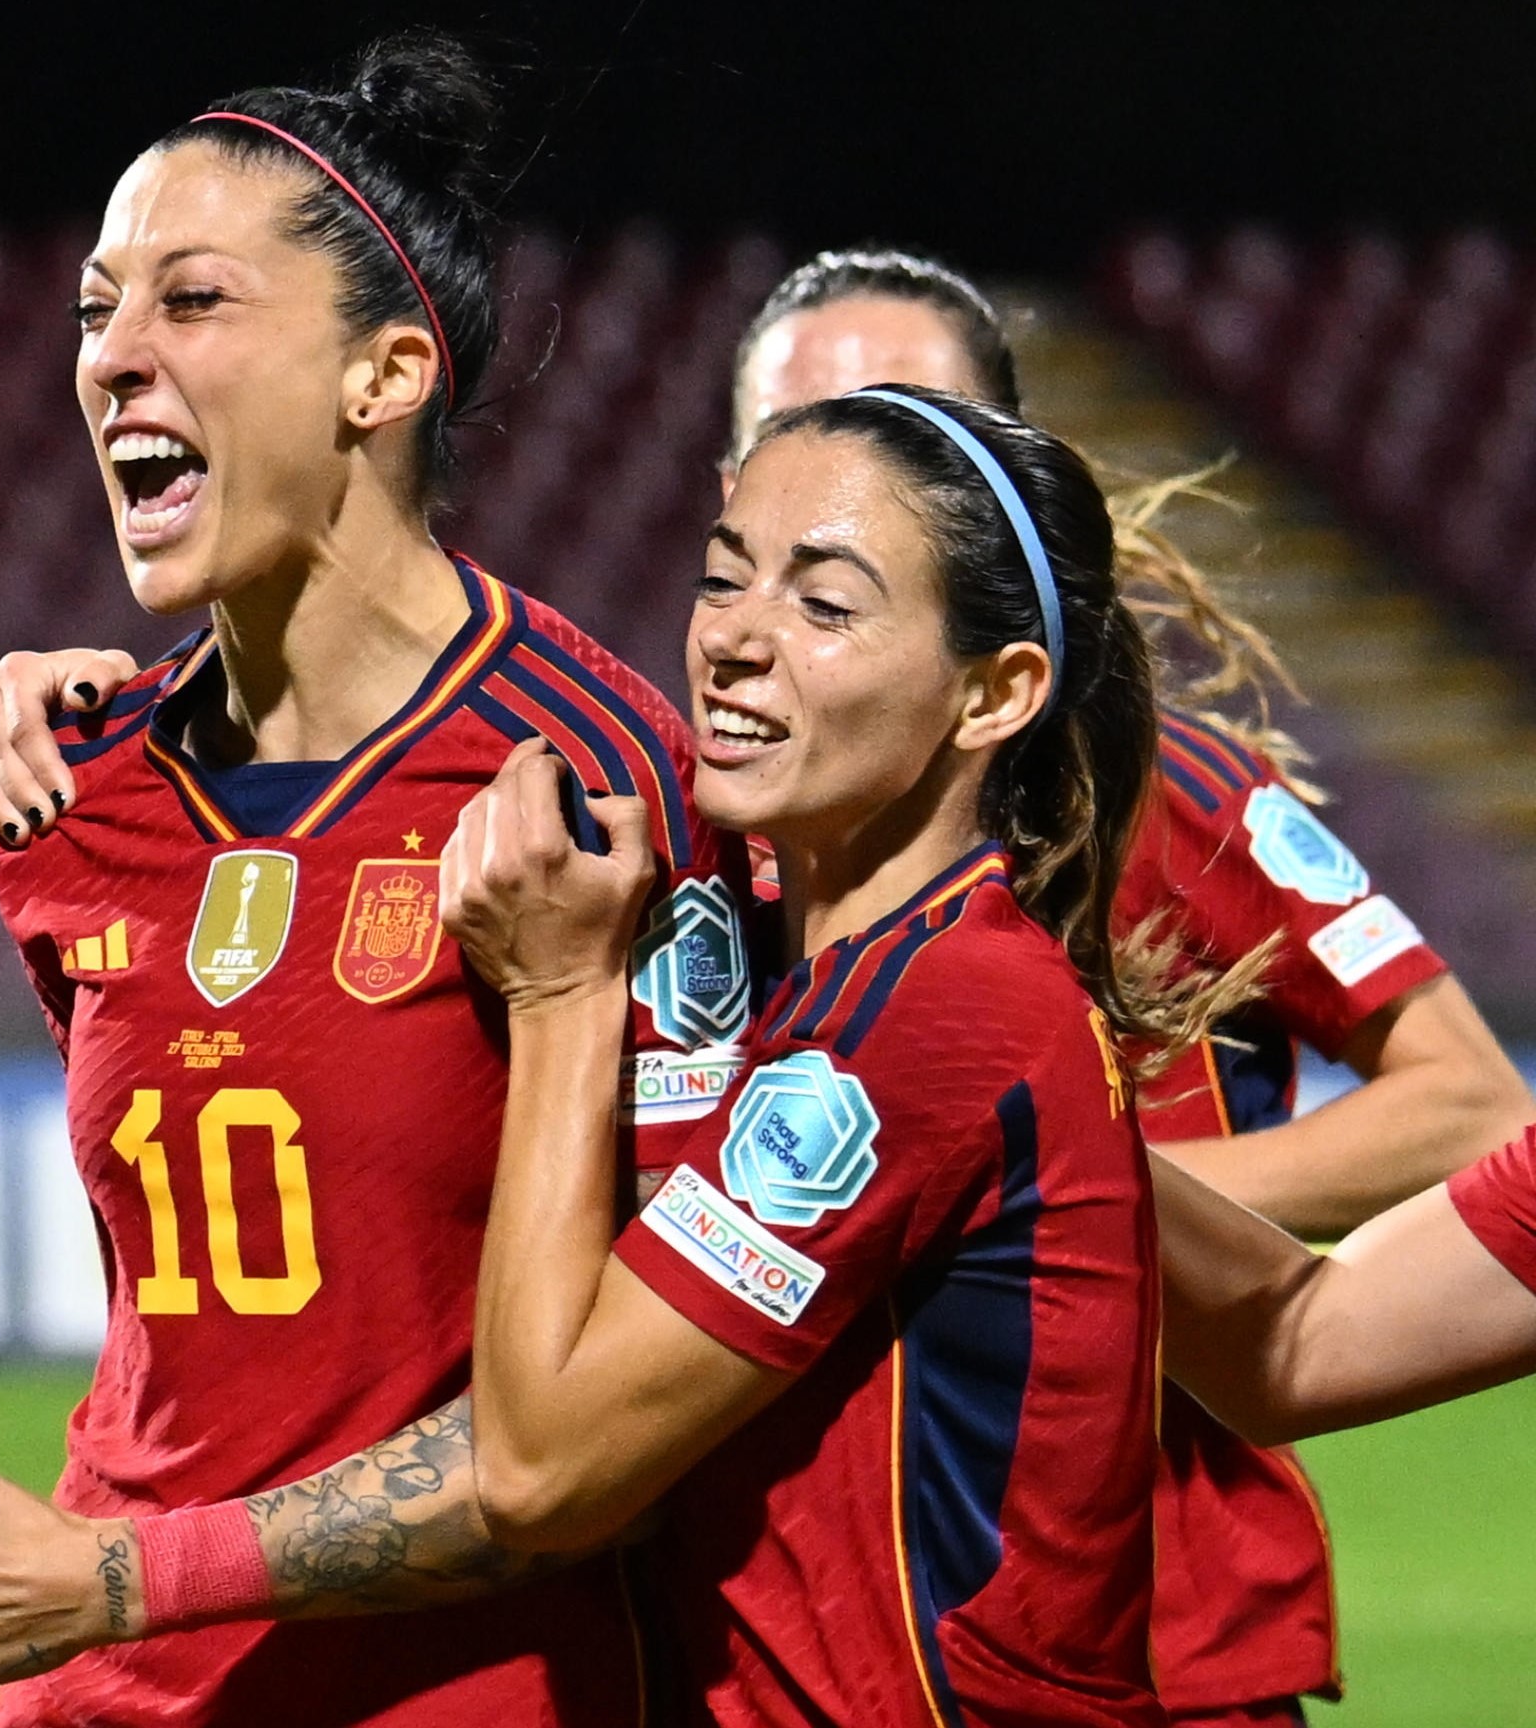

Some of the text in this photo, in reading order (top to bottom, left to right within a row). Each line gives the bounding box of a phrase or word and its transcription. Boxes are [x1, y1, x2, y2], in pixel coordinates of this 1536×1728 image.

[211, 948, 254, 967] FIFA
[685, 956, 716, 976] Play
[686, 975, 731, 995] Strong
[167, 1042, 181, 1054] 27
[767, 1112, 801, 1149] Play
[758, 1128, 808, 1180] Strong
[110, 1088, 322, 1315] 10
